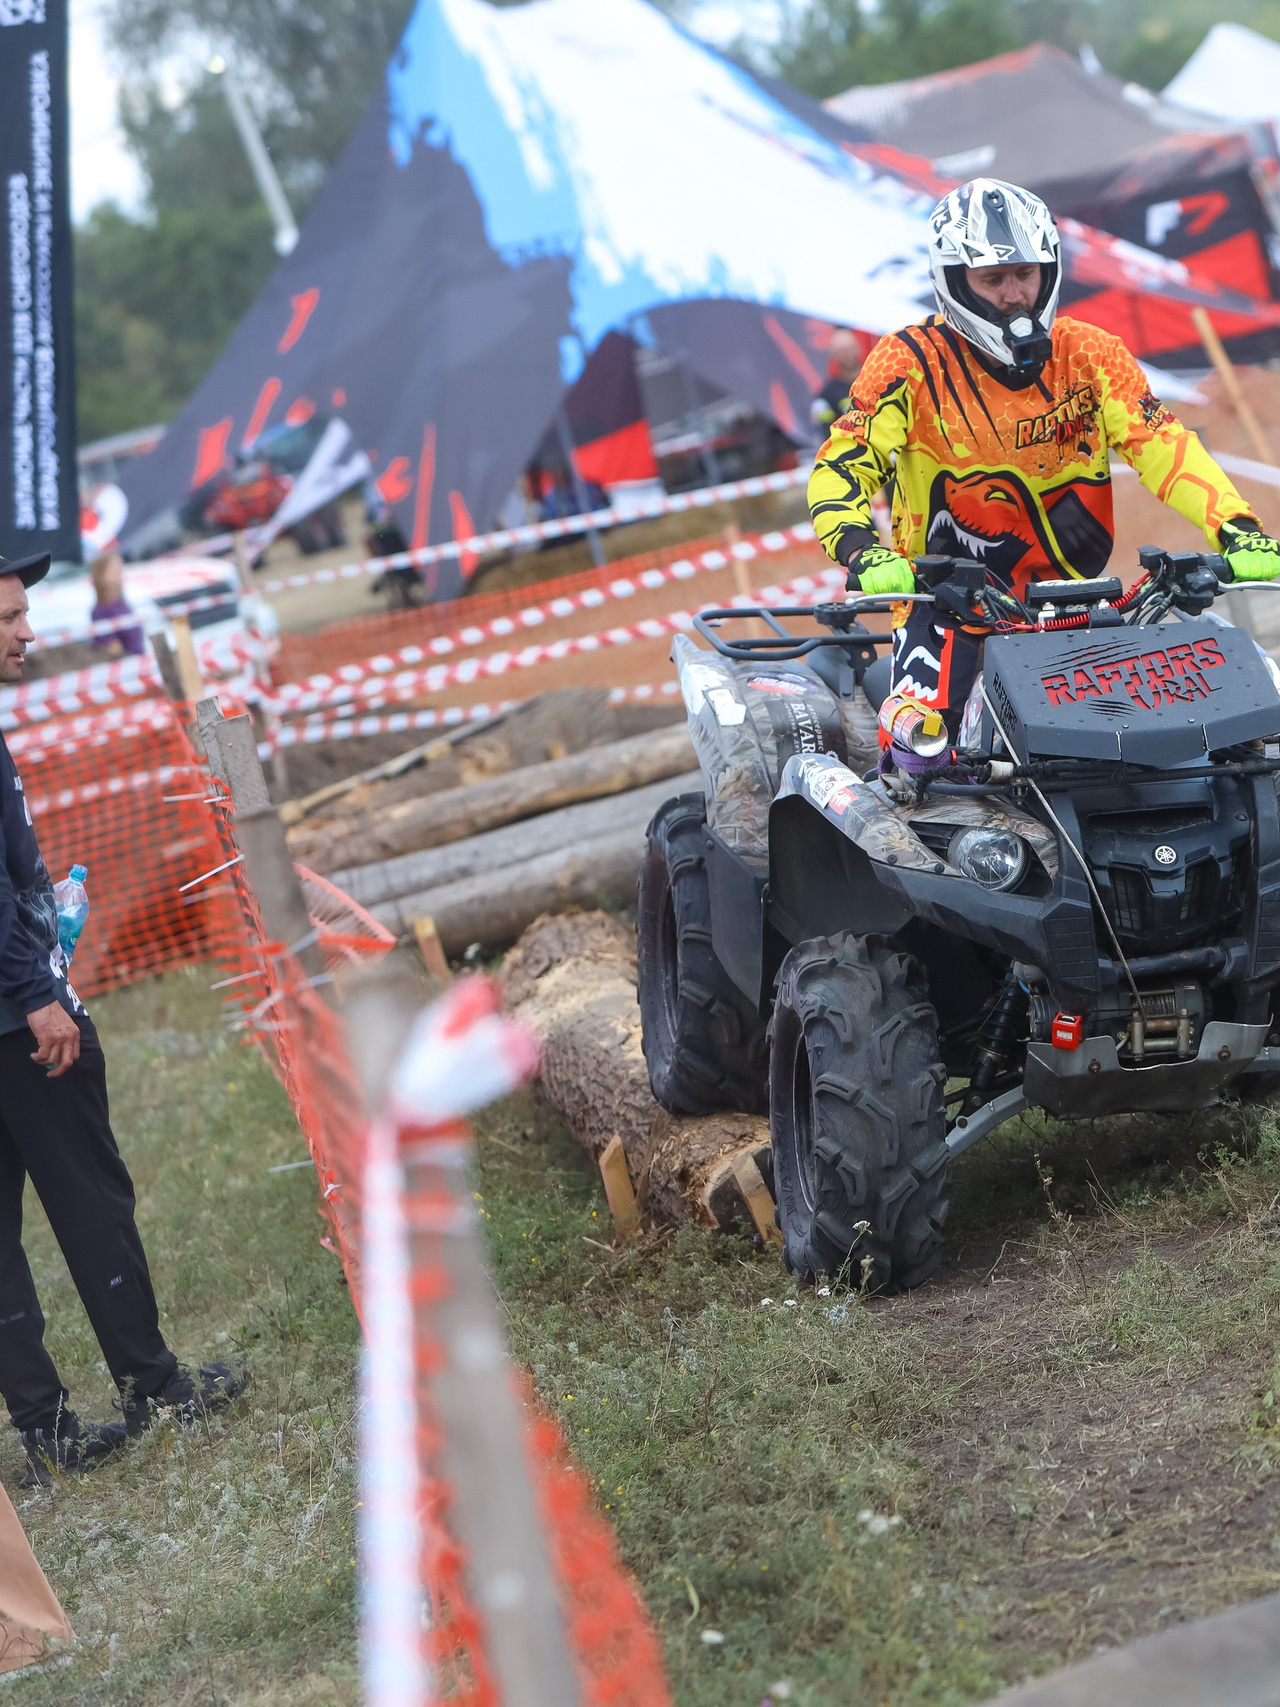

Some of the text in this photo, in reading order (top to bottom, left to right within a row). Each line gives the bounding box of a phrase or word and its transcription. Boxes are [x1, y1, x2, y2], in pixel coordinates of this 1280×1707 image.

[1016, 386, 1097, 449] RAPTORS
[1040, 637, 1226, 706] RAPTORS
[1125, 672, 1222, 710] URAL
